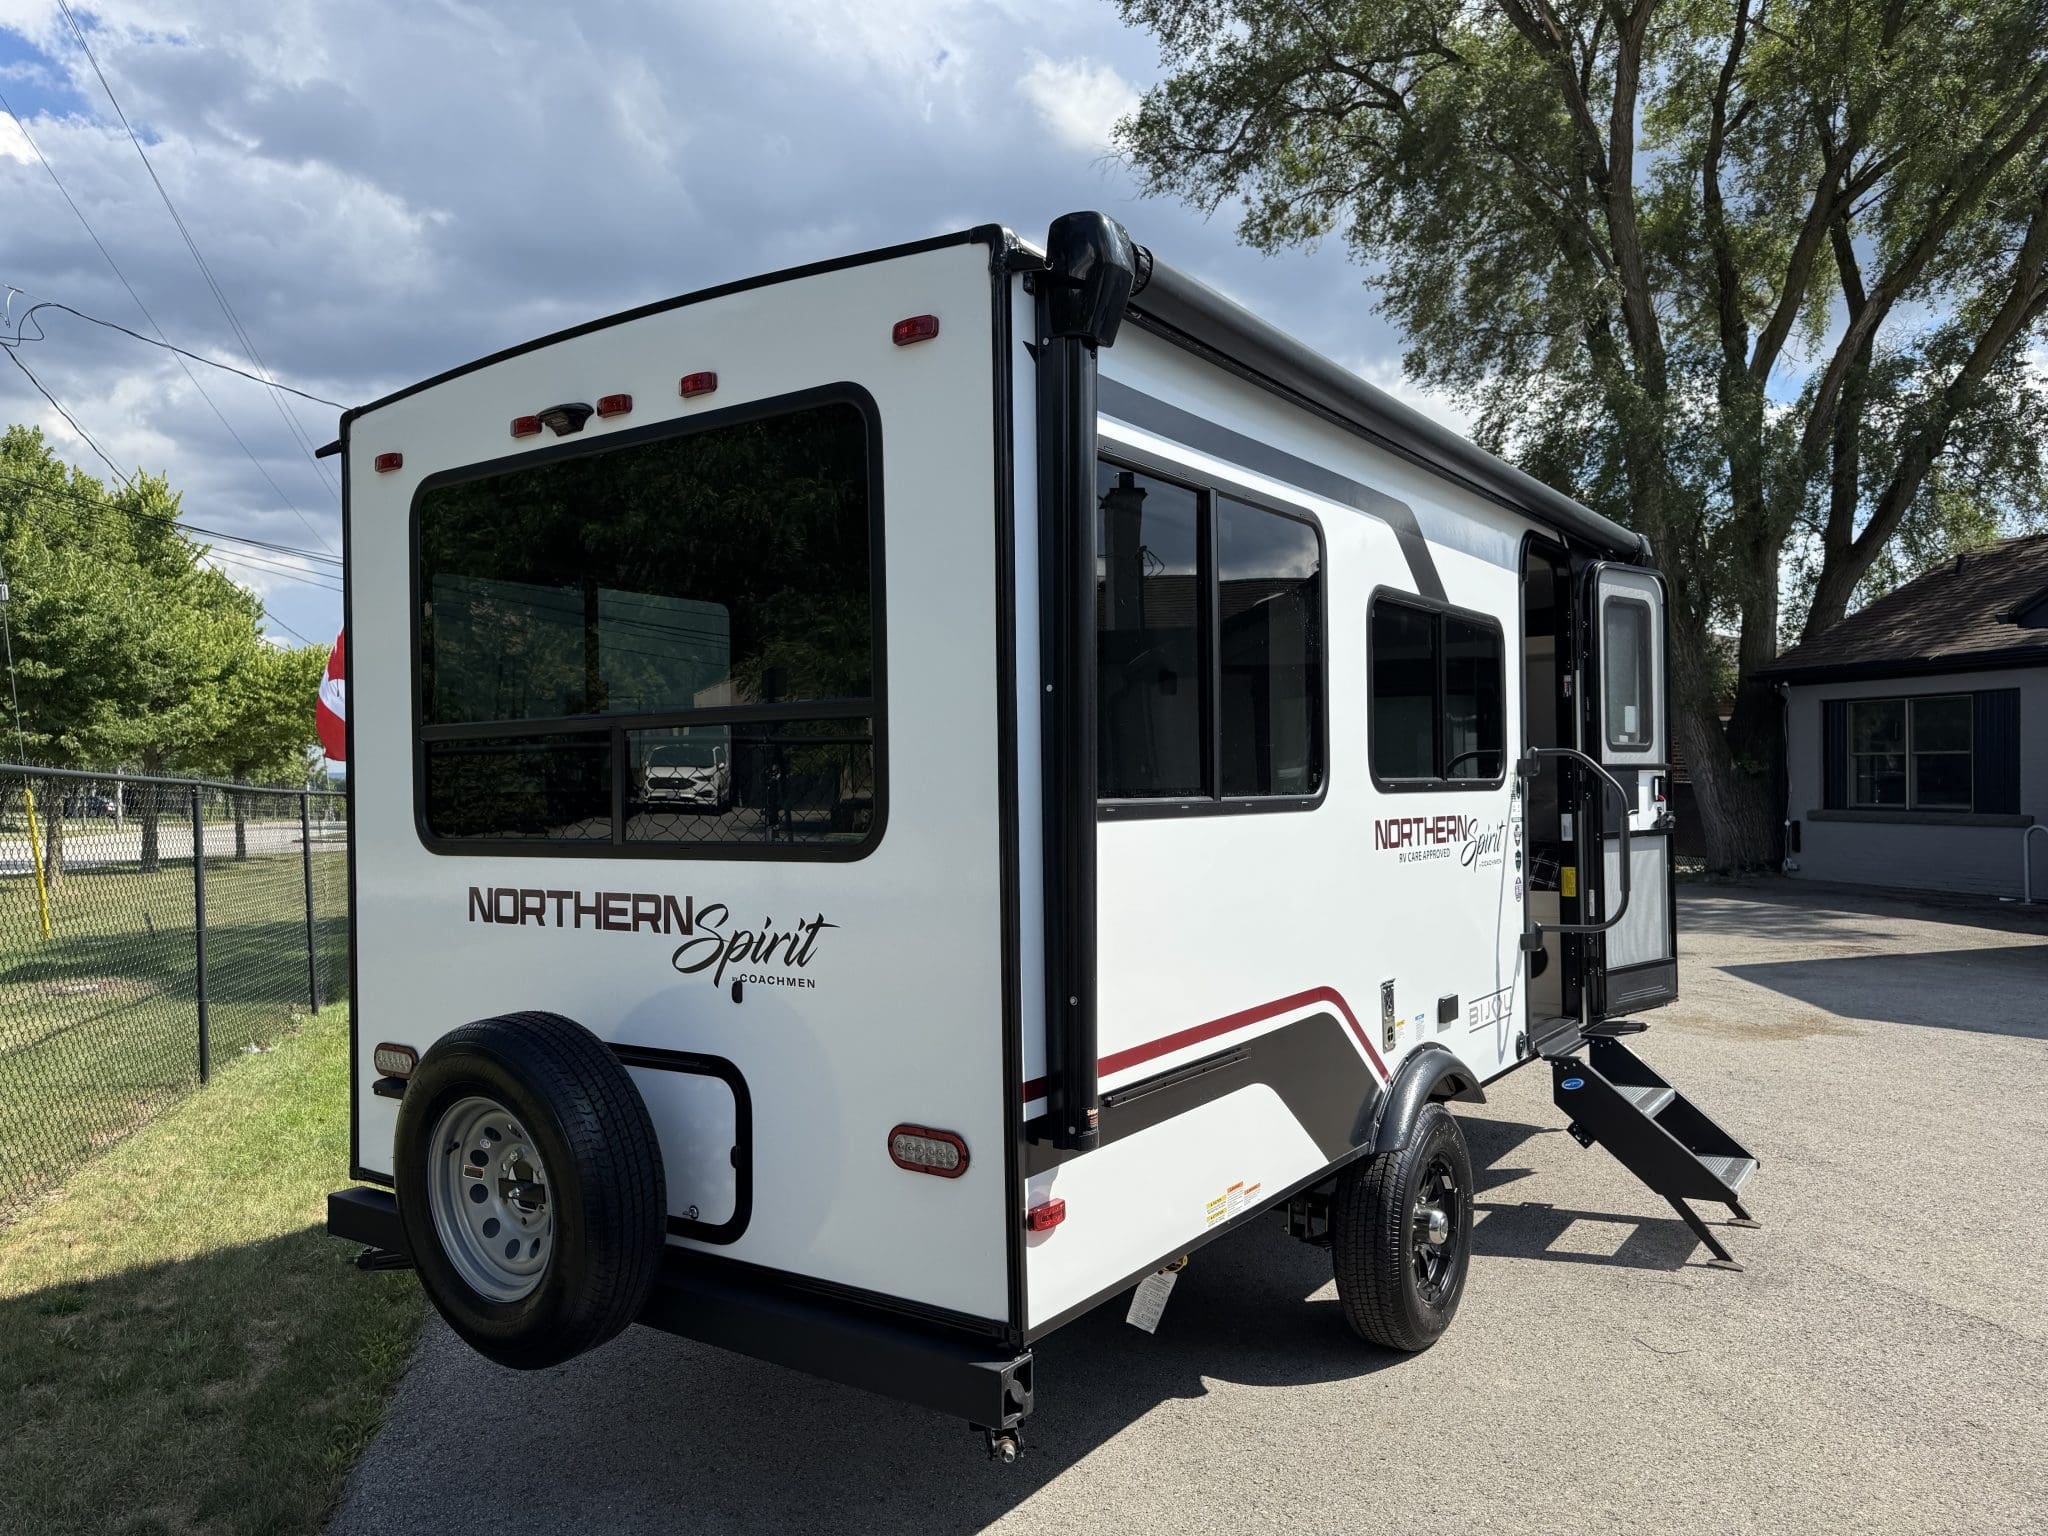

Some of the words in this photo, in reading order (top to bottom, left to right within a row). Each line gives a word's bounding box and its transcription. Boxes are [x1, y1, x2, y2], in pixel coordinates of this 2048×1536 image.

[1375, 815, 1467, 850] NORTHERN
[1461, 818, 1506, 872] Spirit
[1399, 853, 1406, 863] RV
[1407, 851, 1422, 863] CARE
[1423, 848, 1450, 860] APPROVED
[469, 887, 693, 935] NORTHERN
[672, 904, 840, 988] Spirit
[739, 973, 816, 989] COACHMEN
